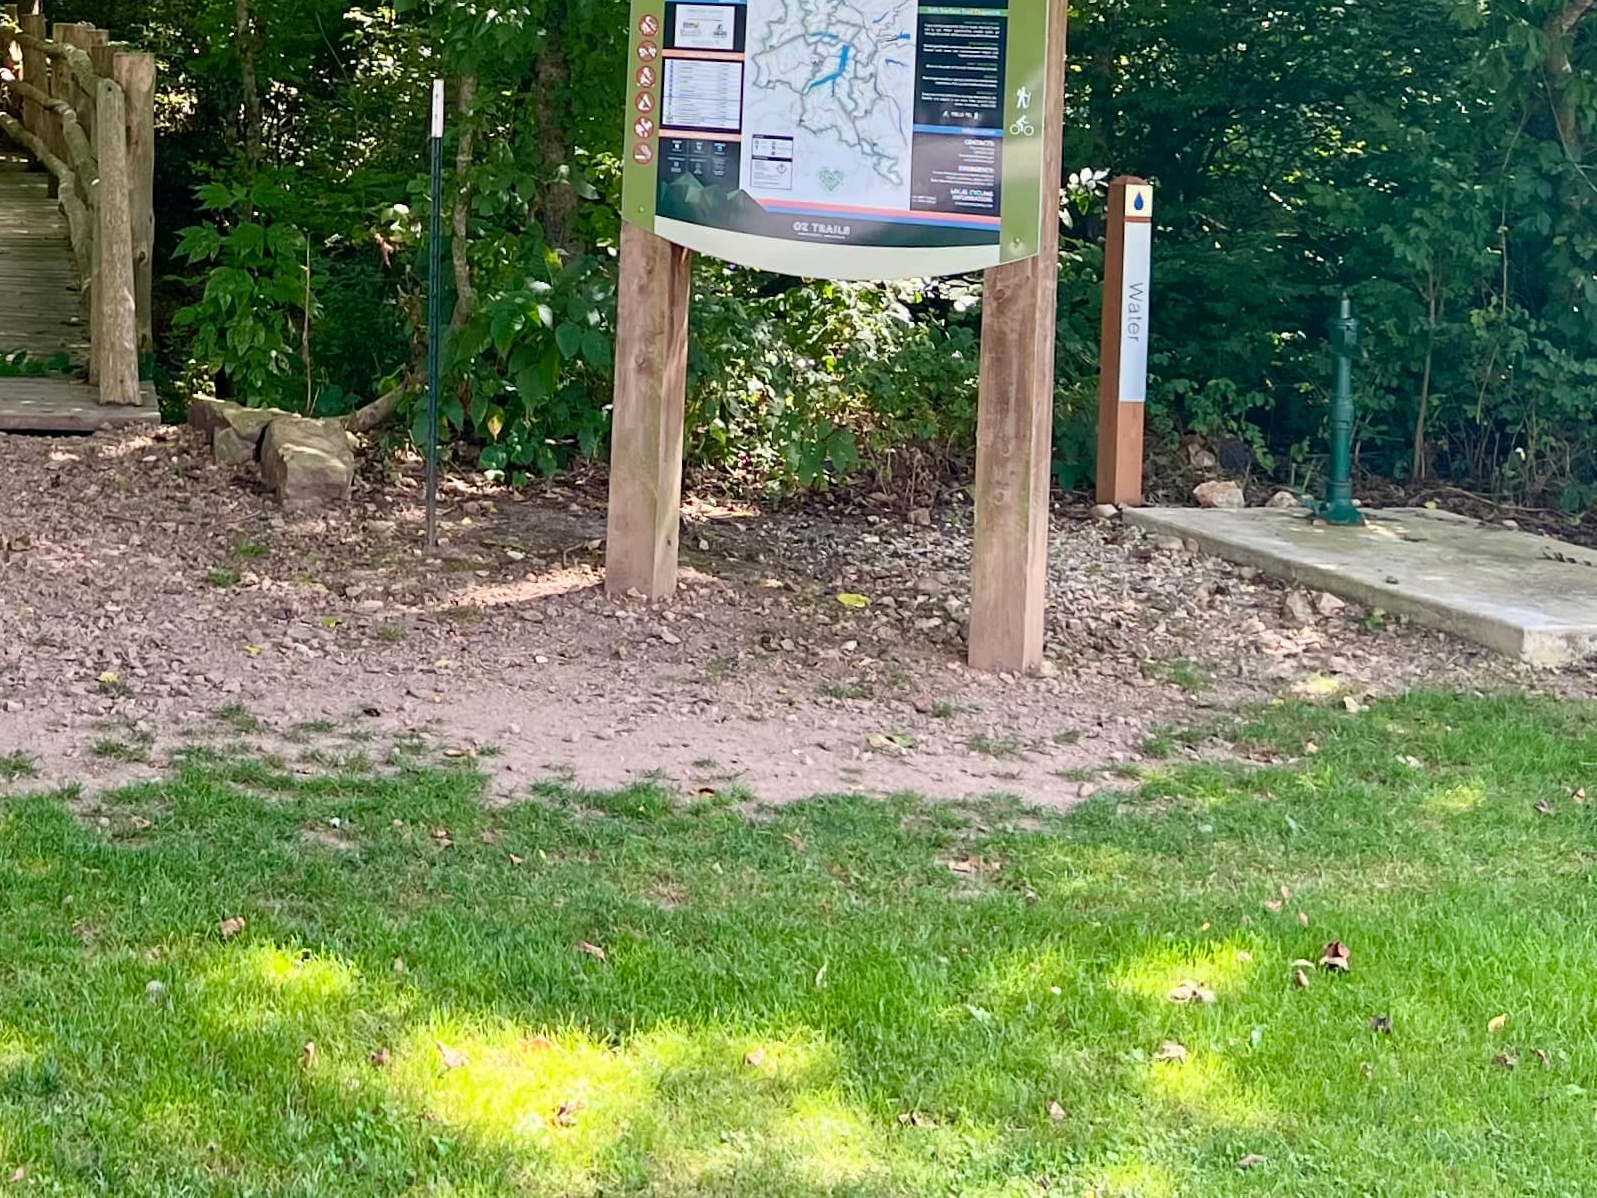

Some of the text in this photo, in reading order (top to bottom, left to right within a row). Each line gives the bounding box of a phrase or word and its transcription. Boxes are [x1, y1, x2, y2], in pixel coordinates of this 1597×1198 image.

[793, 221, 809, 232] OZ
[811, 223, 851, 236] TRAILS
[1126, 282, 1144, 343] Water
